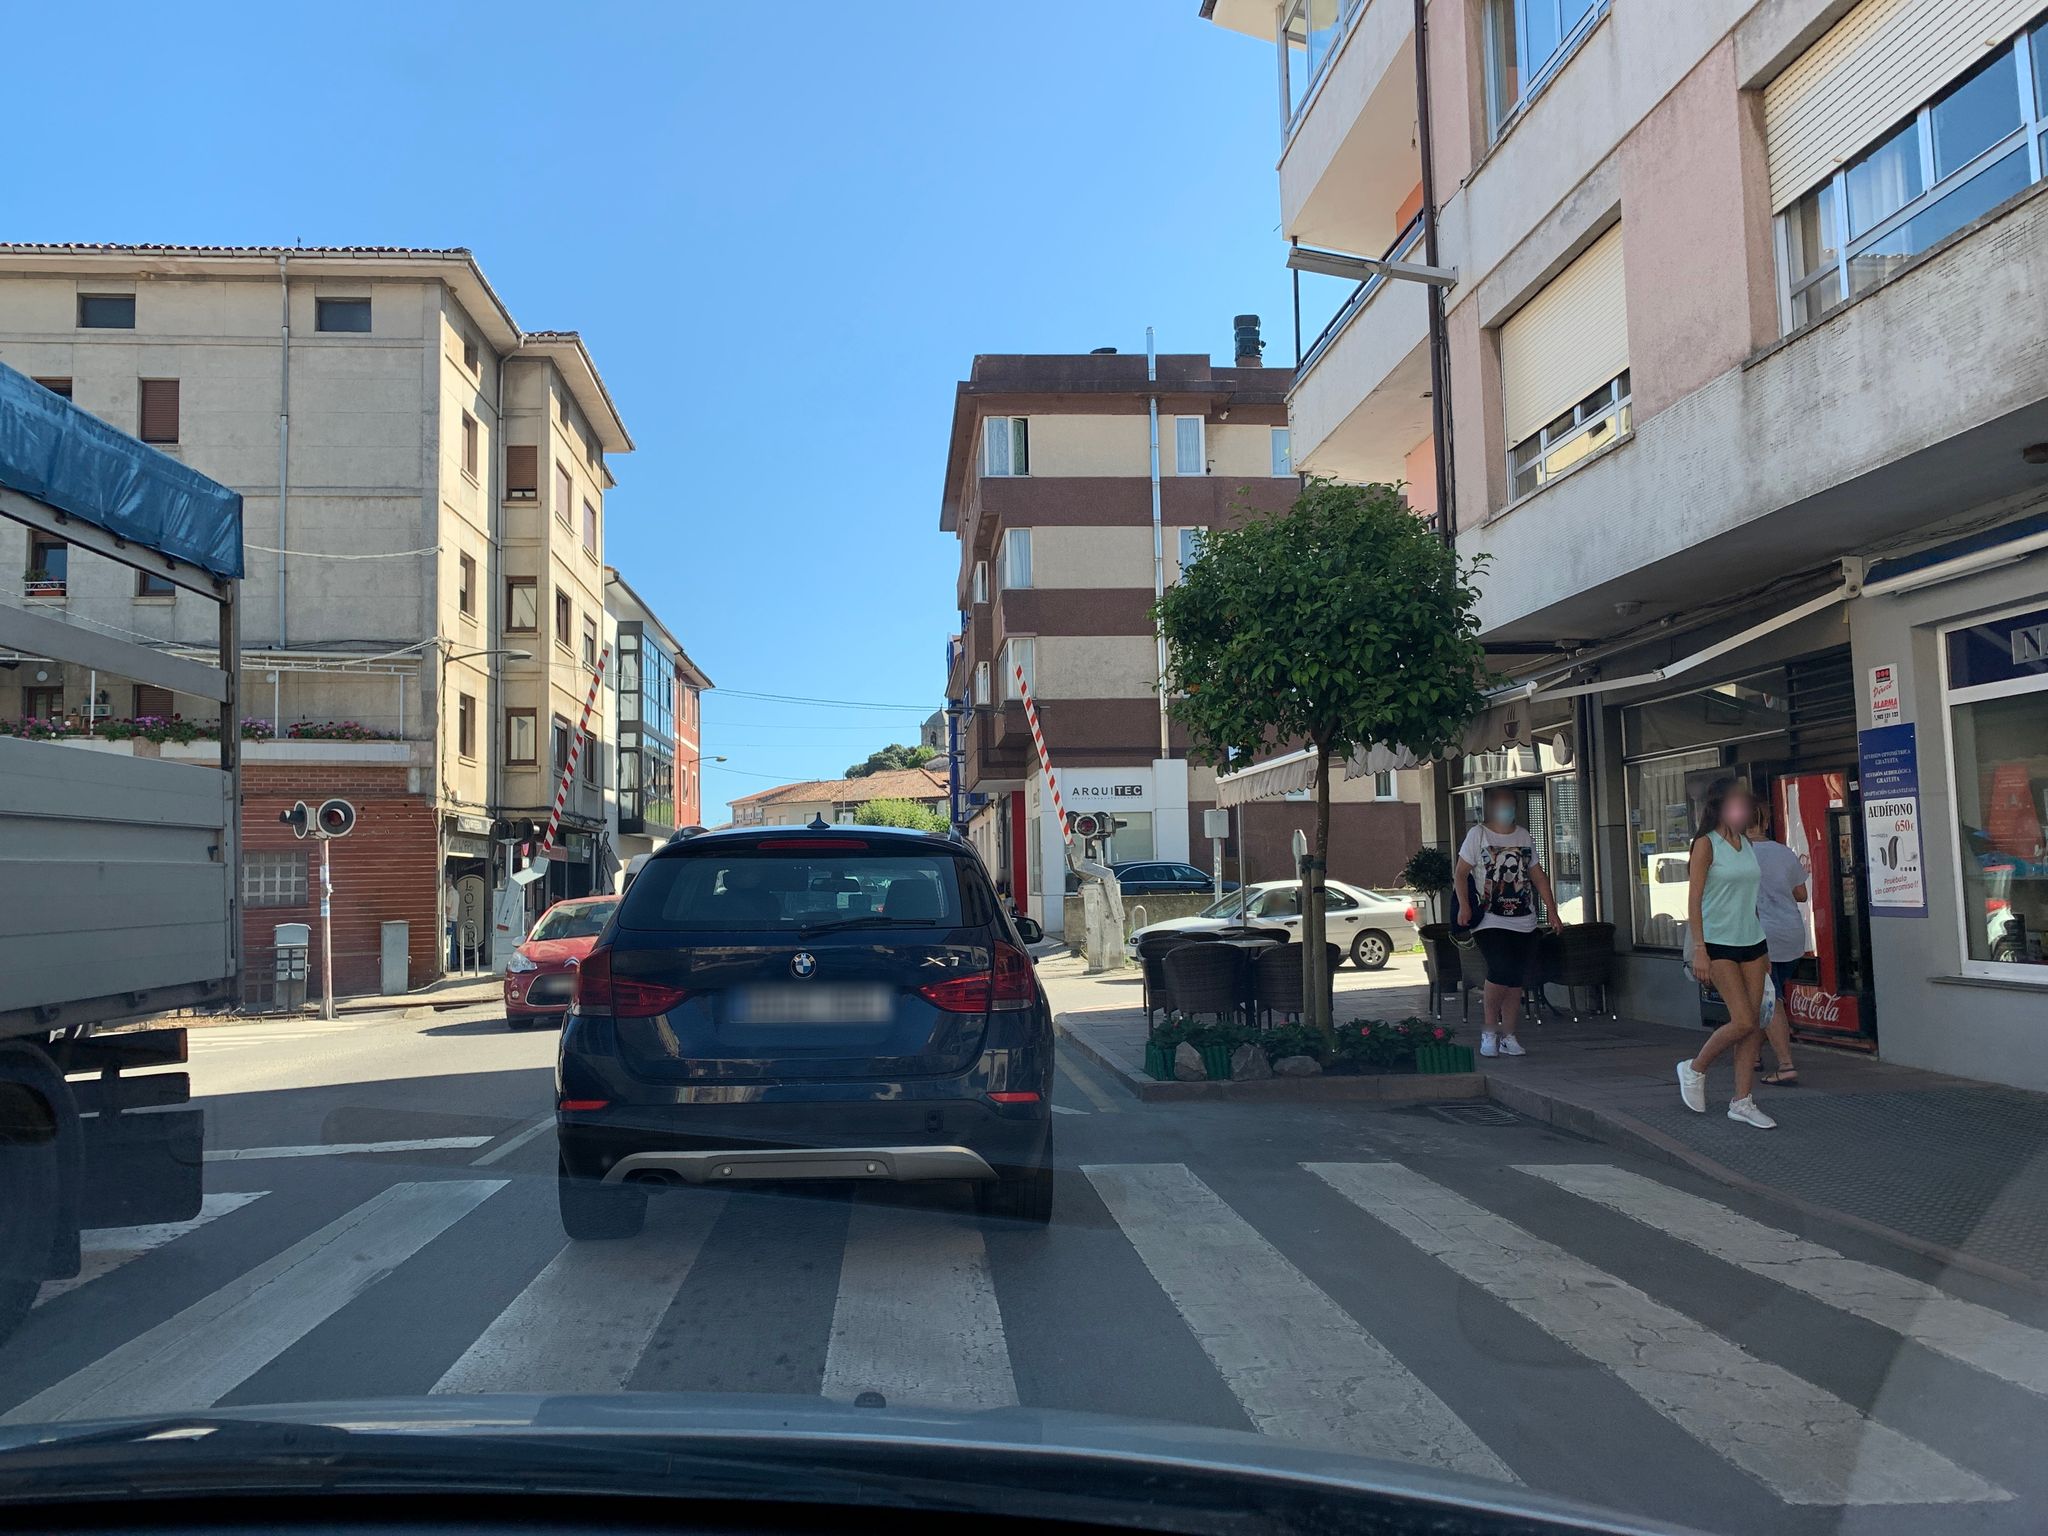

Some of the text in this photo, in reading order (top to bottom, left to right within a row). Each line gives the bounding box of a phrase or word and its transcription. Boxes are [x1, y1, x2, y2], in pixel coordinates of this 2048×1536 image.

[1873, 697, 1898, 709] ALARMA
[1072, 786, 1142, 796] ARQUITEC
[1868, 802, 1913, 818] AUDÍFONO
